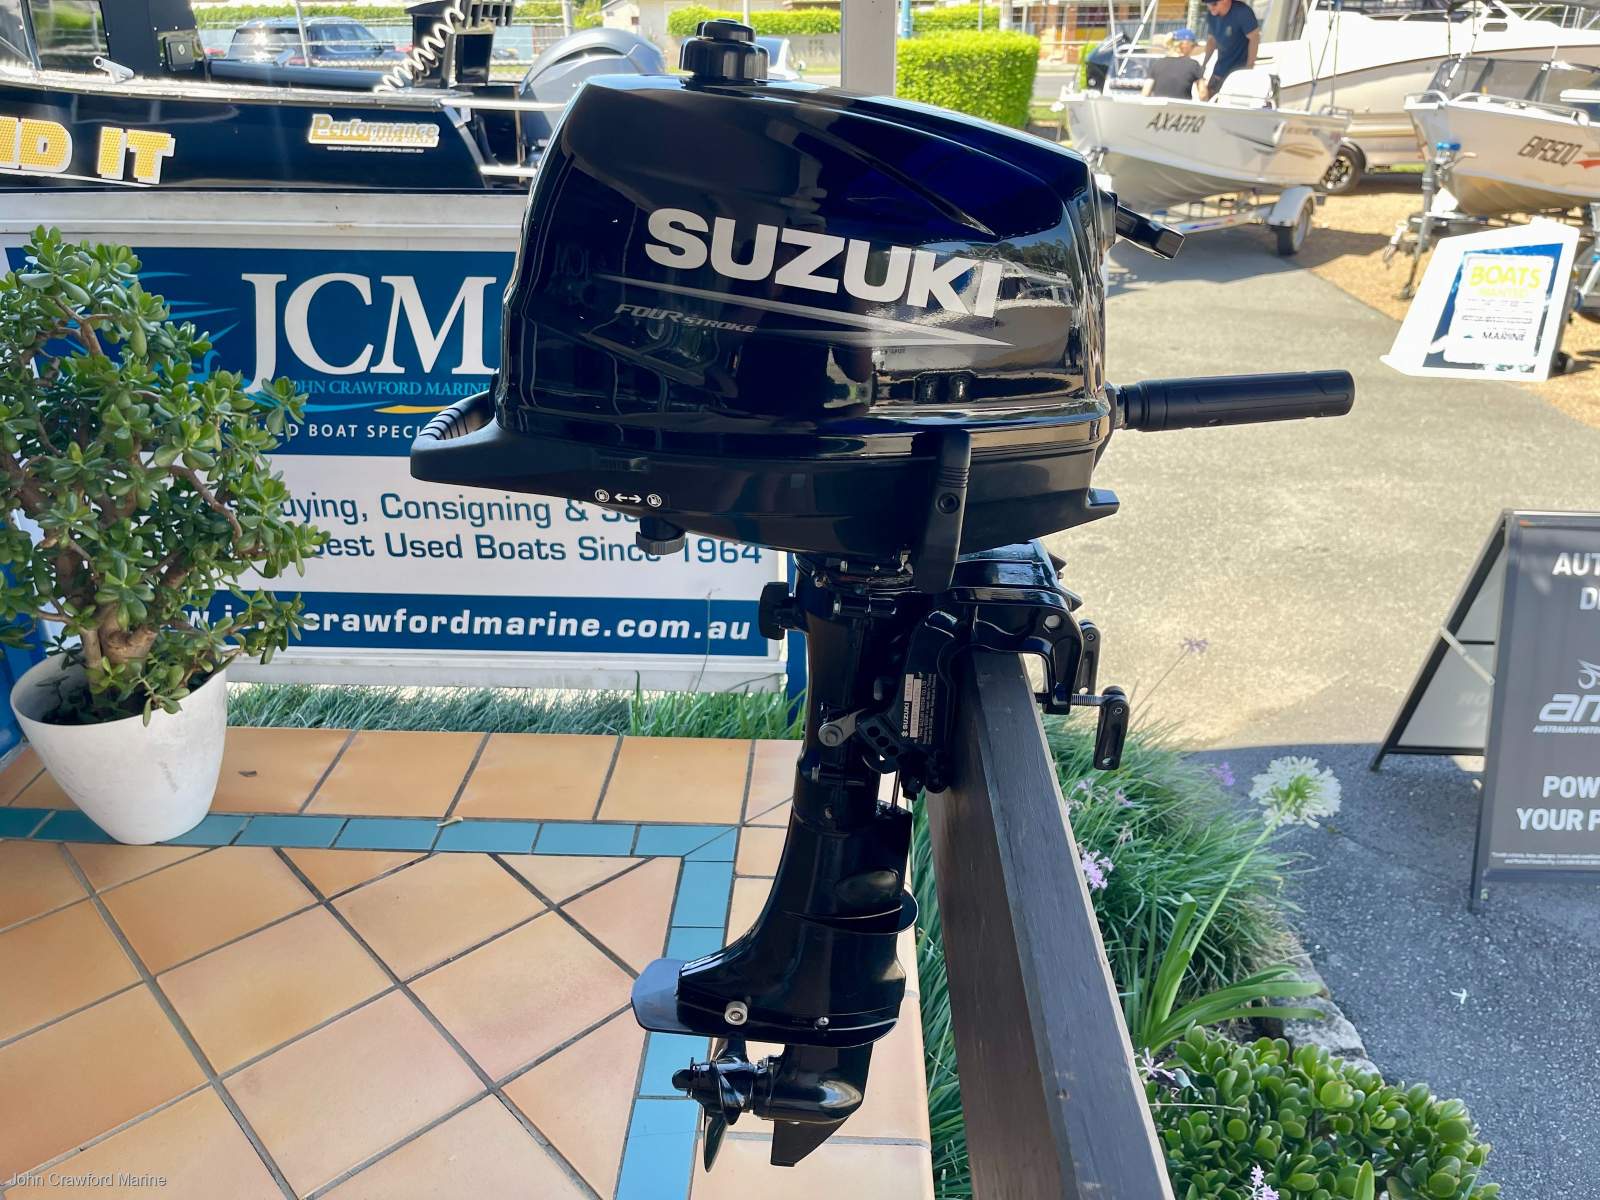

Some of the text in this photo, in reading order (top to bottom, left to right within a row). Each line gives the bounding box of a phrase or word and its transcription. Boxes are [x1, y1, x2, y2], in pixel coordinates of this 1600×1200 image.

[311, 114, 439, 138] Performance
[97, 126, 176, 185] IT
[645, 207, 1003, 318] SUZUKI
[1469, 264, 1543, 289] BOATS
[614, 303, 758, 333] FOUR STROKE
[241, 272, 499, 393] JCM
[294, 380, 325, 394] OHN
[329, 380, 422, 395] CRAWFORD
[309, 424, 358, 438] BOAT
[281, 491, 589, 529] uying, Consigning &
[384, 532, 464, 559] Used
[475, 534, 567, 561] Boats
[684, 537, 763, 564] 1964
[1542, 775, 1600, 798] POW
[1516, 808, 1584, 831] YOUR
